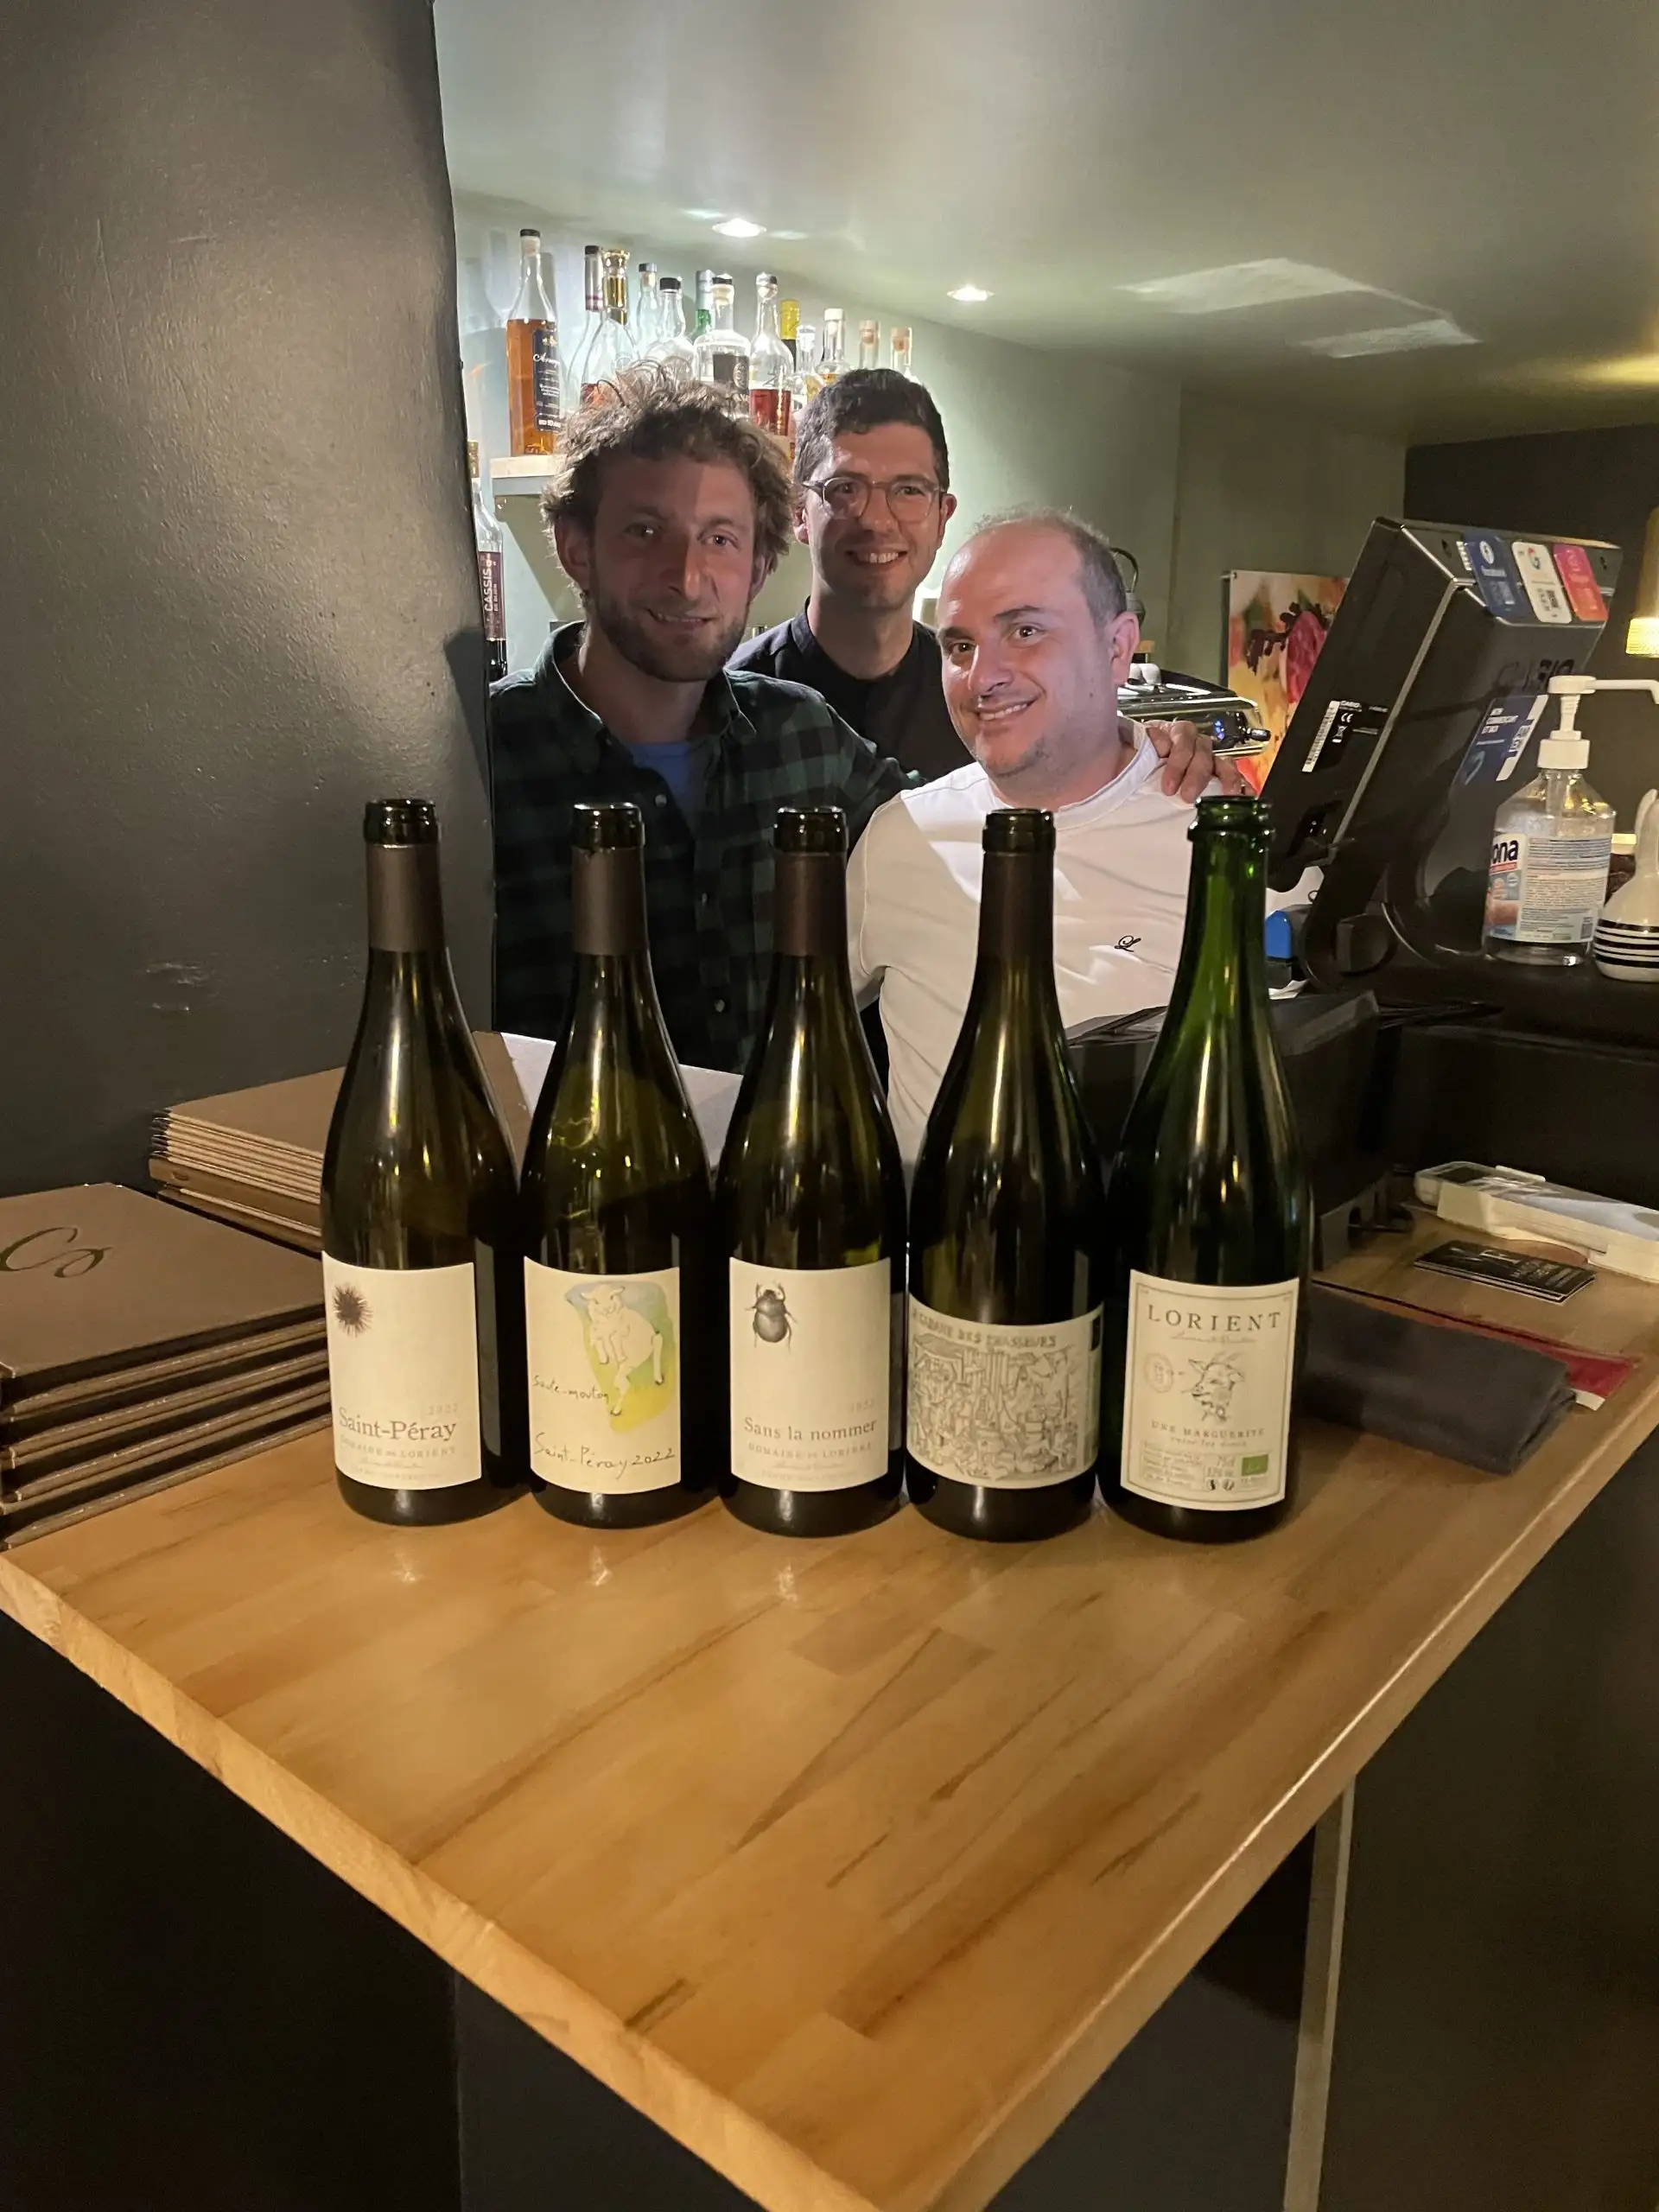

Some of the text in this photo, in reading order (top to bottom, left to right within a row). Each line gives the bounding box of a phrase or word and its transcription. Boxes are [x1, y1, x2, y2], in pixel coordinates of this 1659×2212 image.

[482, 569, 493, 612] CASSIS
[1147, 1304, 1281, 1332] LORIENT
[338, 1406, 457, 1442] Saint-Péray
[744, 1416, 877, 1441] Sans la nommer
[1183, 1427, 1266, 1440] MARGUERITE
[631, 1448, 677, 1466] 2022
[747, 1442, 802, 1459] DOMAINE
